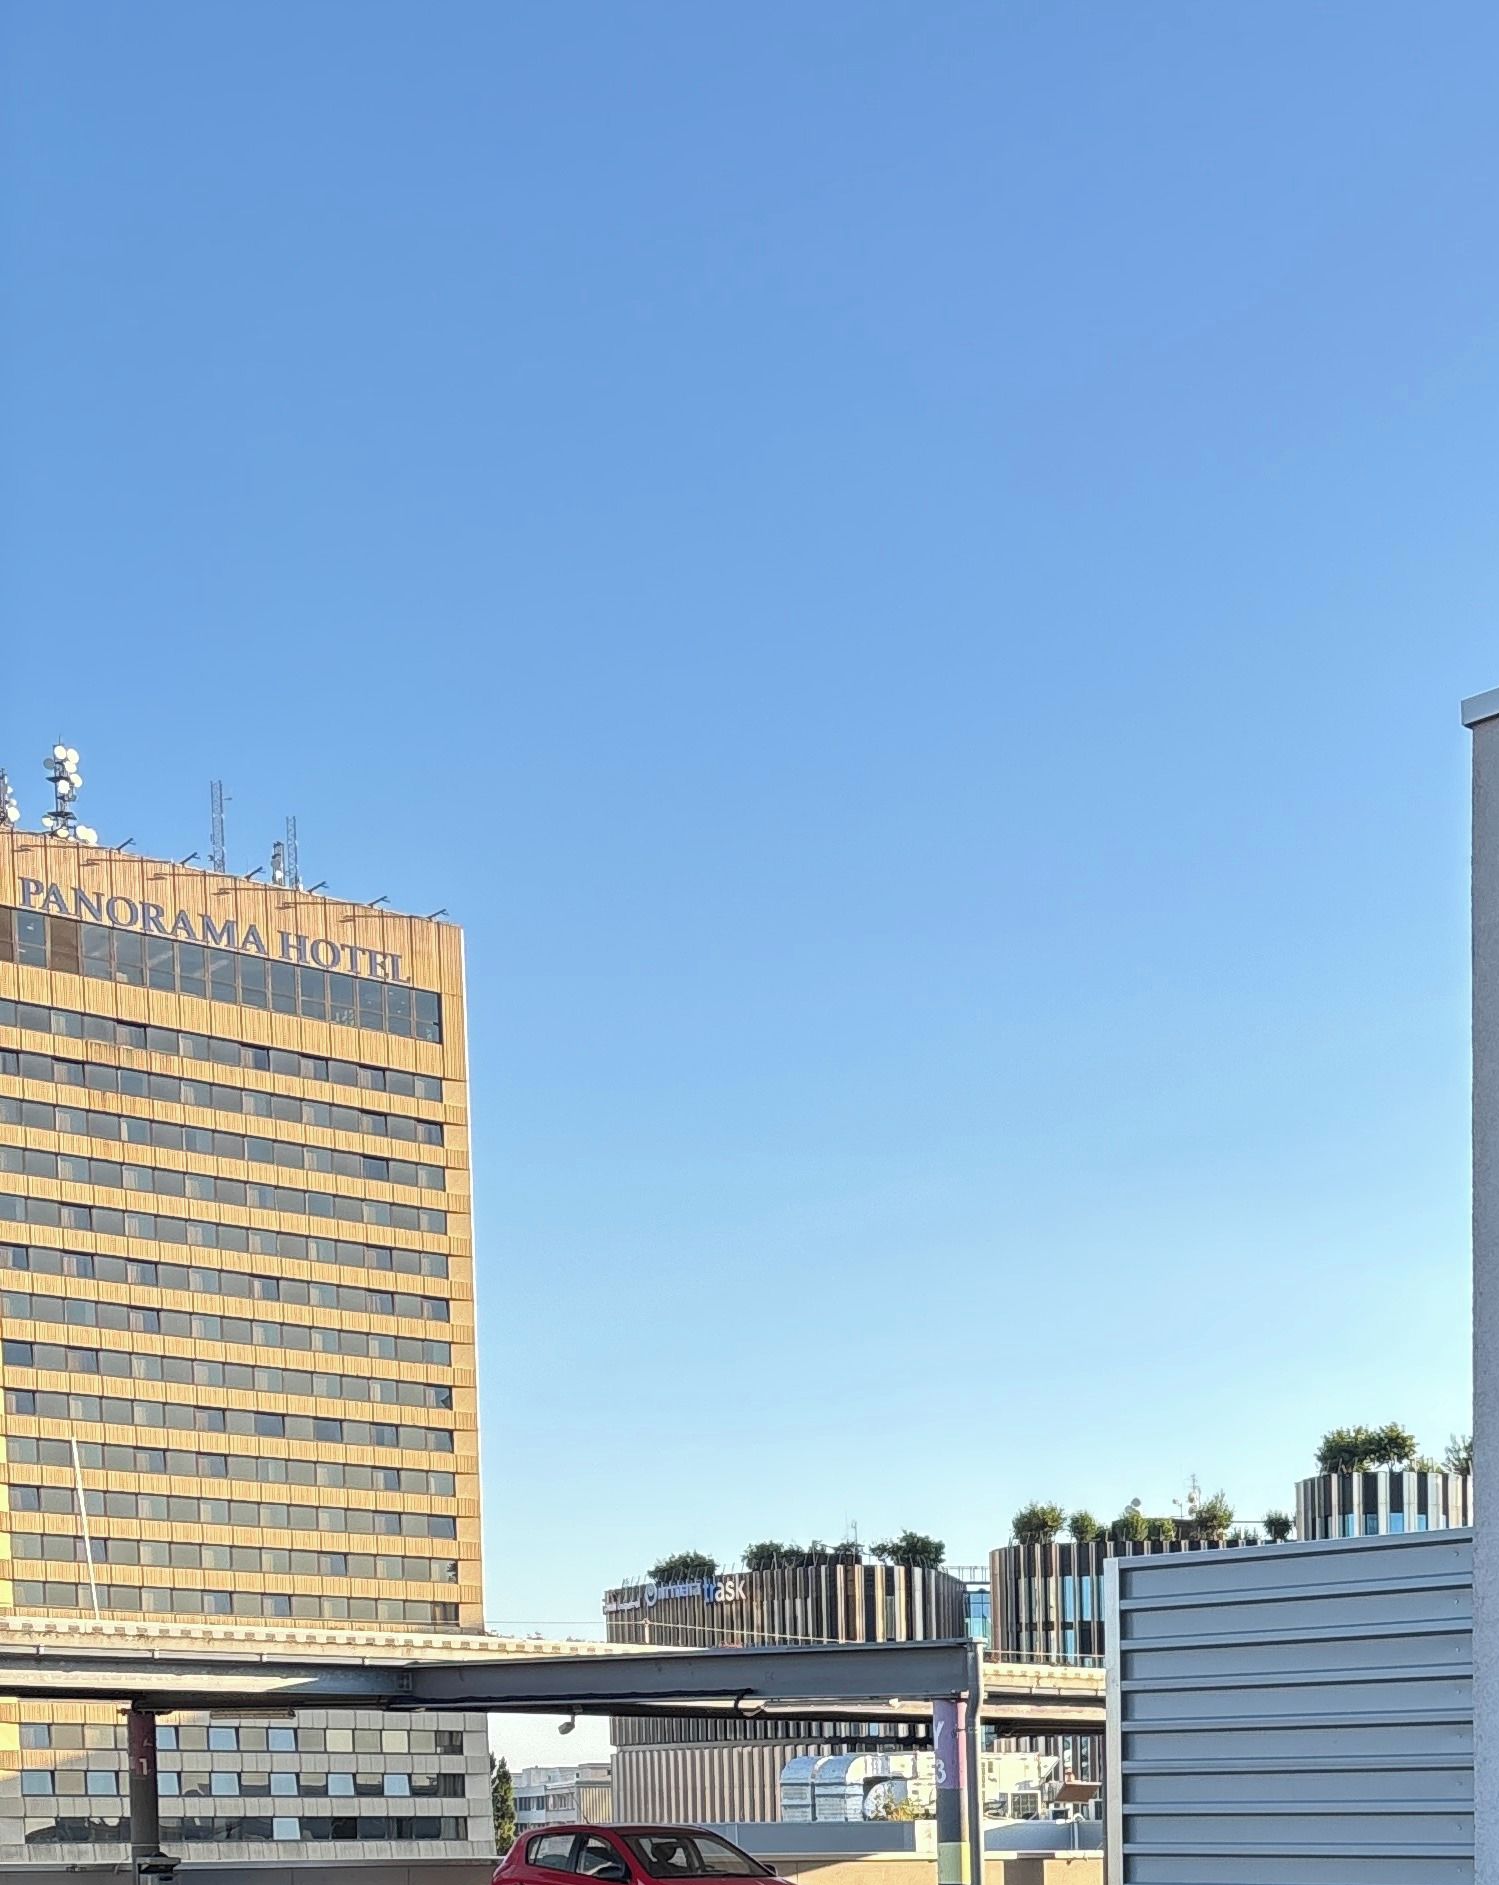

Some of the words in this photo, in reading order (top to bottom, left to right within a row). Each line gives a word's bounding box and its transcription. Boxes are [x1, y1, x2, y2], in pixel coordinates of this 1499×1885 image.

[18, 876, 268, 956] PANORAMA
[277, 929, 412, 982] HOTEL
[703, 1575, 747, 1605] trask
